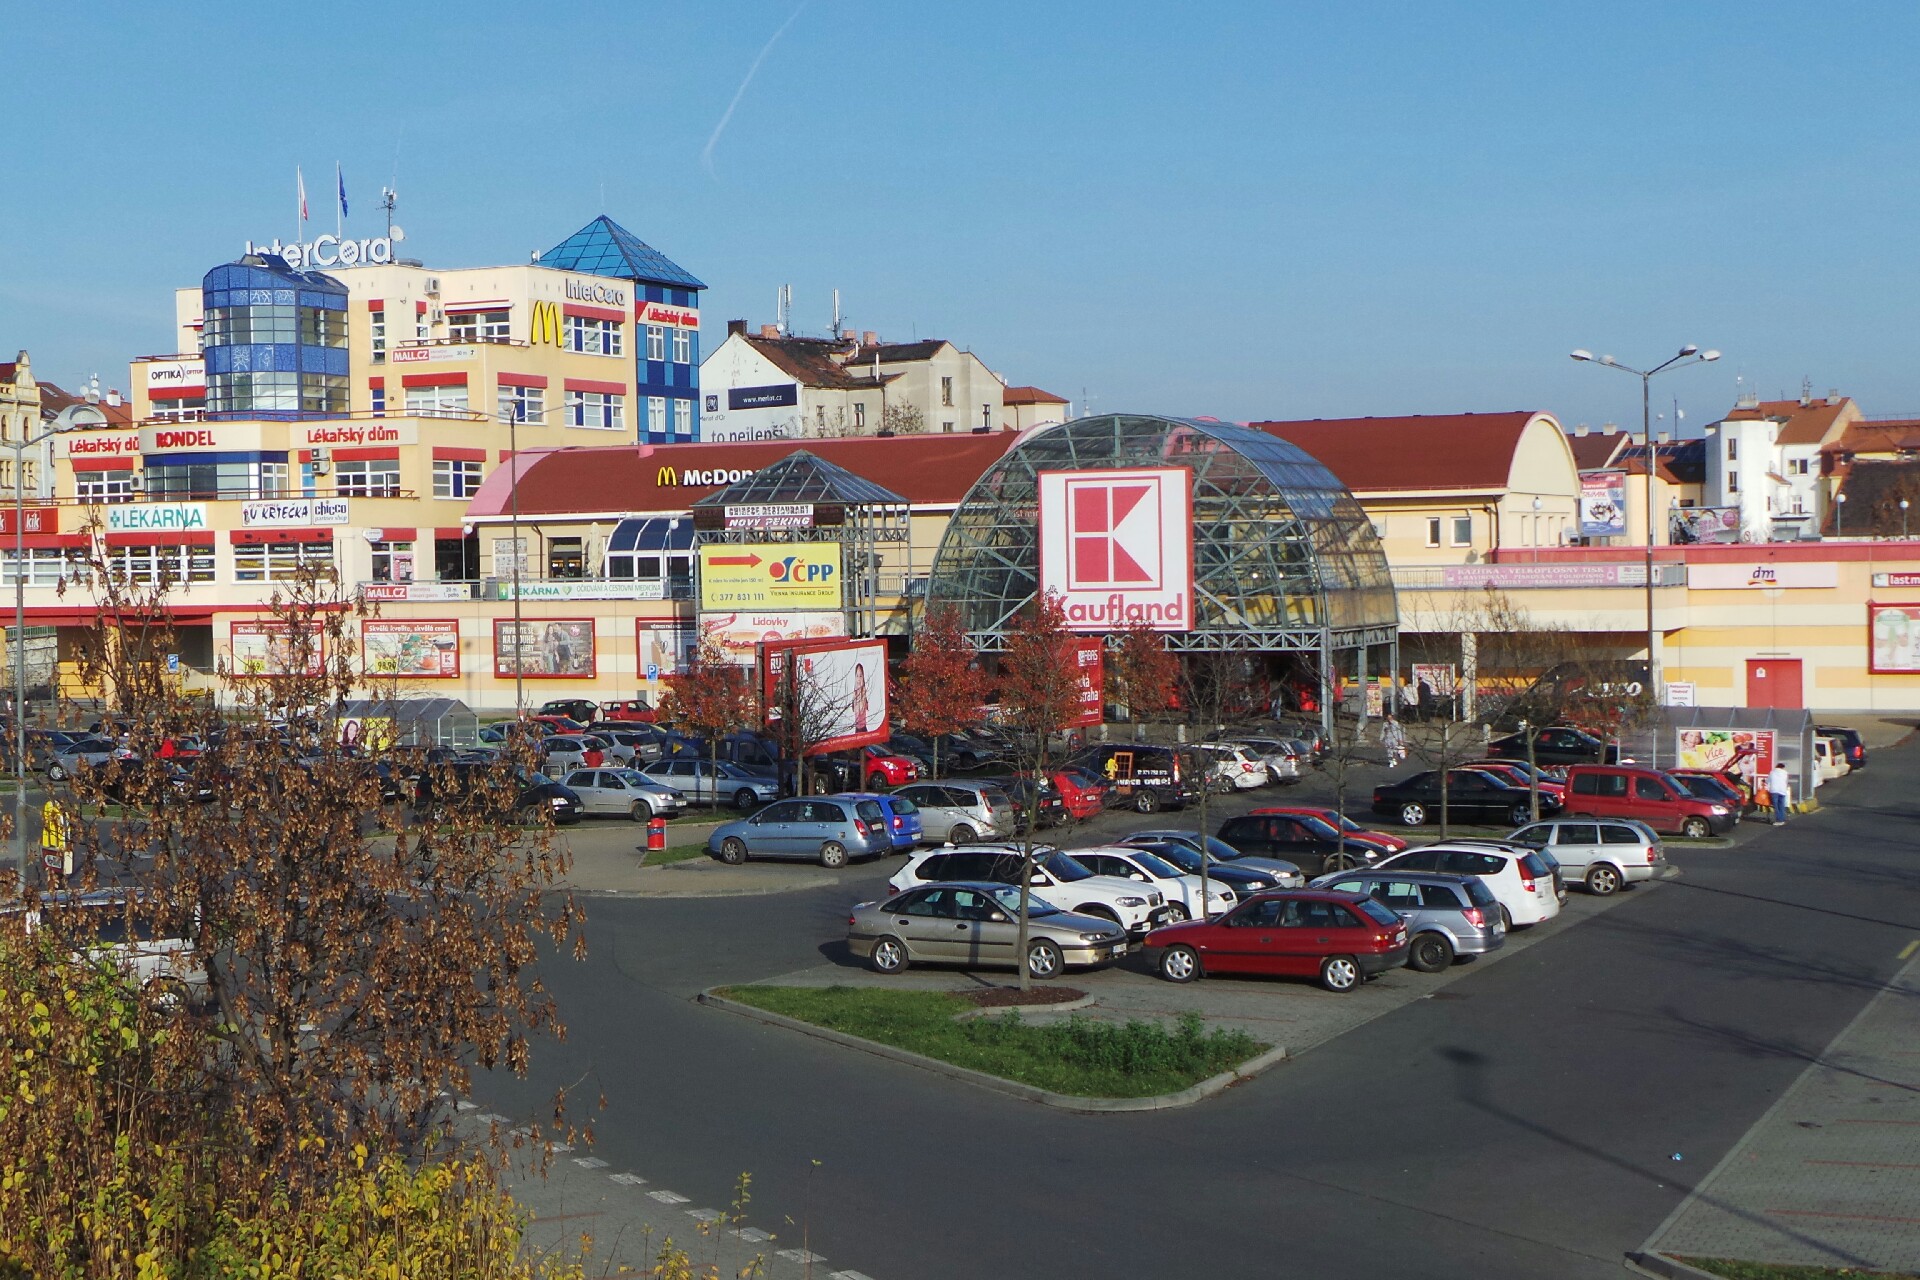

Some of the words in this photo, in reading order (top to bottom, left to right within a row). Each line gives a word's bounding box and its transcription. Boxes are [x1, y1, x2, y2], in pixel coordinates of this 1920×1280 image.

[246, 235, 391, 269] InterCora
[566, 278, 625, 306] InterCora
[681, 312, 698, 326] dům
[394, 350, 429, 361] MALL.CZ
[151, 370, 182, 380] OPTIKA
[156, 431, 216, 448] RONDEL
[308, 427, 364, 445] Lékařský
[368, 425, 399, 441] dům
[711, 430, 725, 442] to
[729, 426, 783, 442] nejlepší
[69, 437, 121, 454] Lékařský
[125, 434, 140, 451] dů
[250, 508, 258, 519] U
[262, 503, 308, 520] KRTEČKA
[315, 500, 347, 516] chicco
[762, 505, 809, 515] RESTAURANT
[26, 513, 40, 529] kik
[122, 506, 203, 528] LÉKÁRNA
[729, 516, 761, 527] NOVÝ
[766, 516, 810, 527] PEKING
[793, 559, 834, 582] ČPP
[1752, 567, 1775, 579] dm
[1889, 575, 1909, 586] last
[367, 587, 407, 599] MALL.CZ
[511, 586, 559, 596] LÉKÁRNA
[1048, 593, 1183, 622] Kaufland
[414, 624, 434, 632] skvělá
[434, 624, 452, 632] cena!
[752, 617, 789, 627] Lidovky
[1705, 747, 1724, 759] Více
